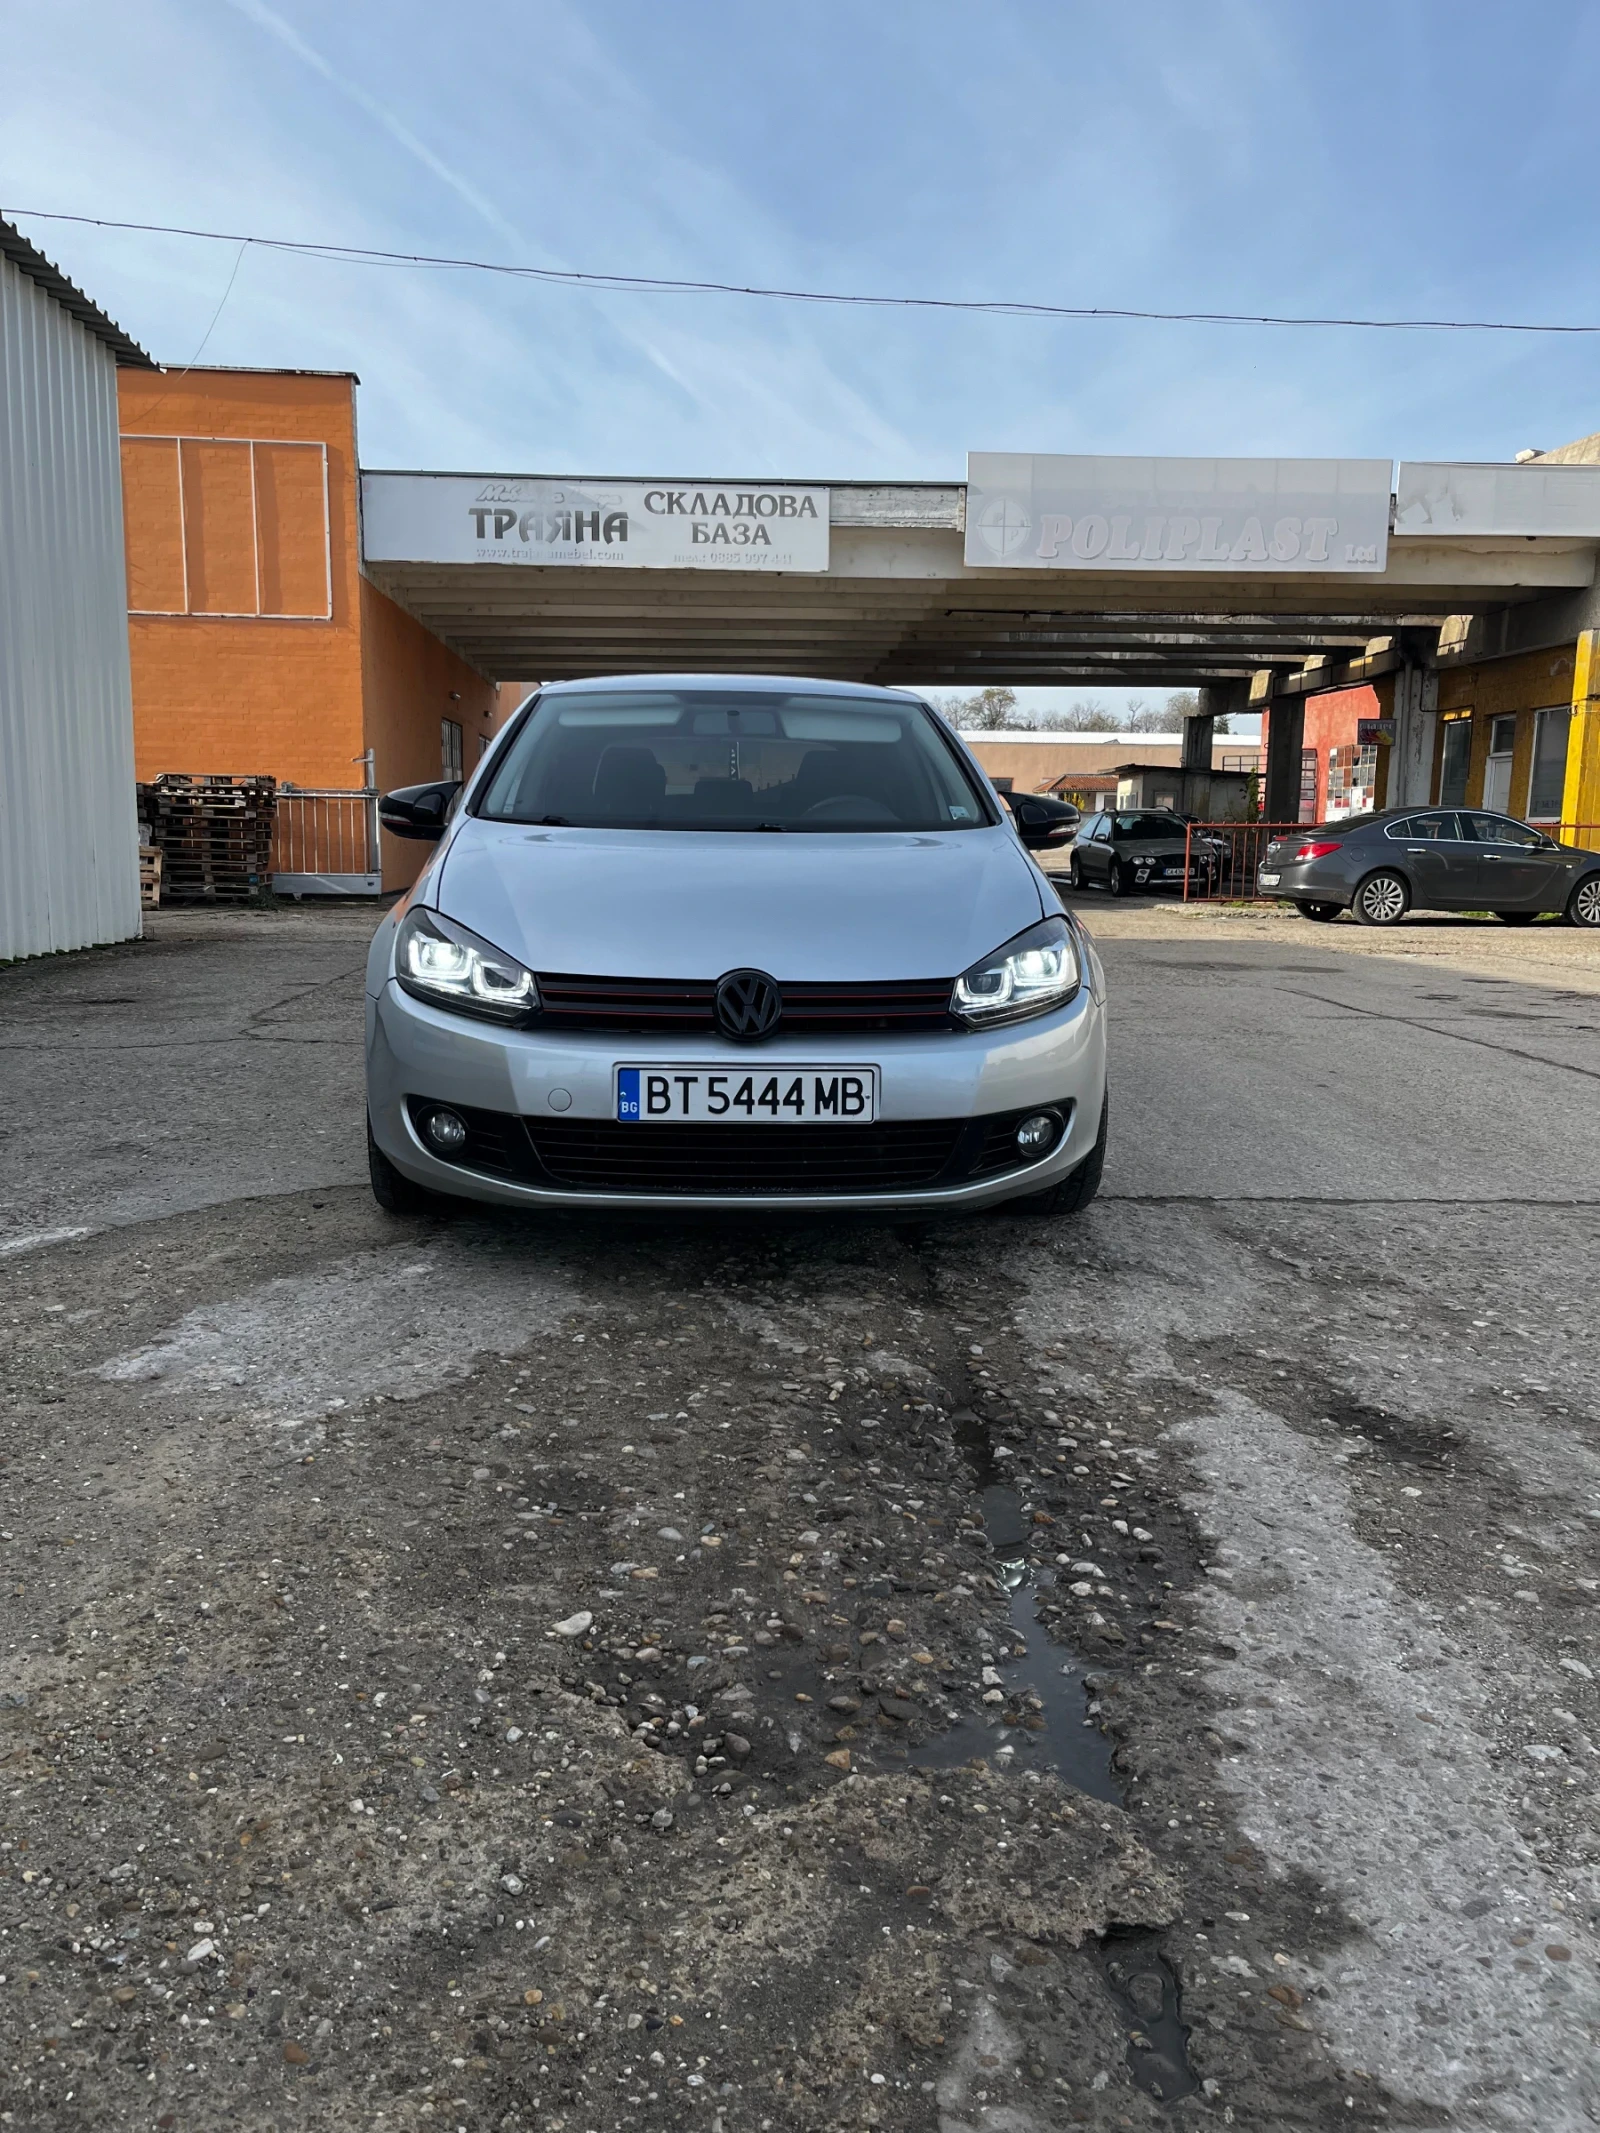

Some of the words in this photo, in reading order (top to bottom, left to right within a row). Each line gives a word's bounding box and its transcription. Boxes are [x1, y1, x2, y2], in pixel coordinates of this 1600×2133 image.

[644, 490, 818, 519] СКЛАДОВА
[468, 507, 629, 545] ТРАЯНА
[691, 522, 772, 546] БАЗА
[1035, 513, 1339, 562] POLIPLAST
[710, 552, 741, 564] 0885
[745, 553, 768, 564] 997
[621, 1101, 638, 1113] BG
[647, 1076, 698, 1115] BT
[707, 1076, 805, 1115] 5444
[814, 1077, 865, 1116] MB
